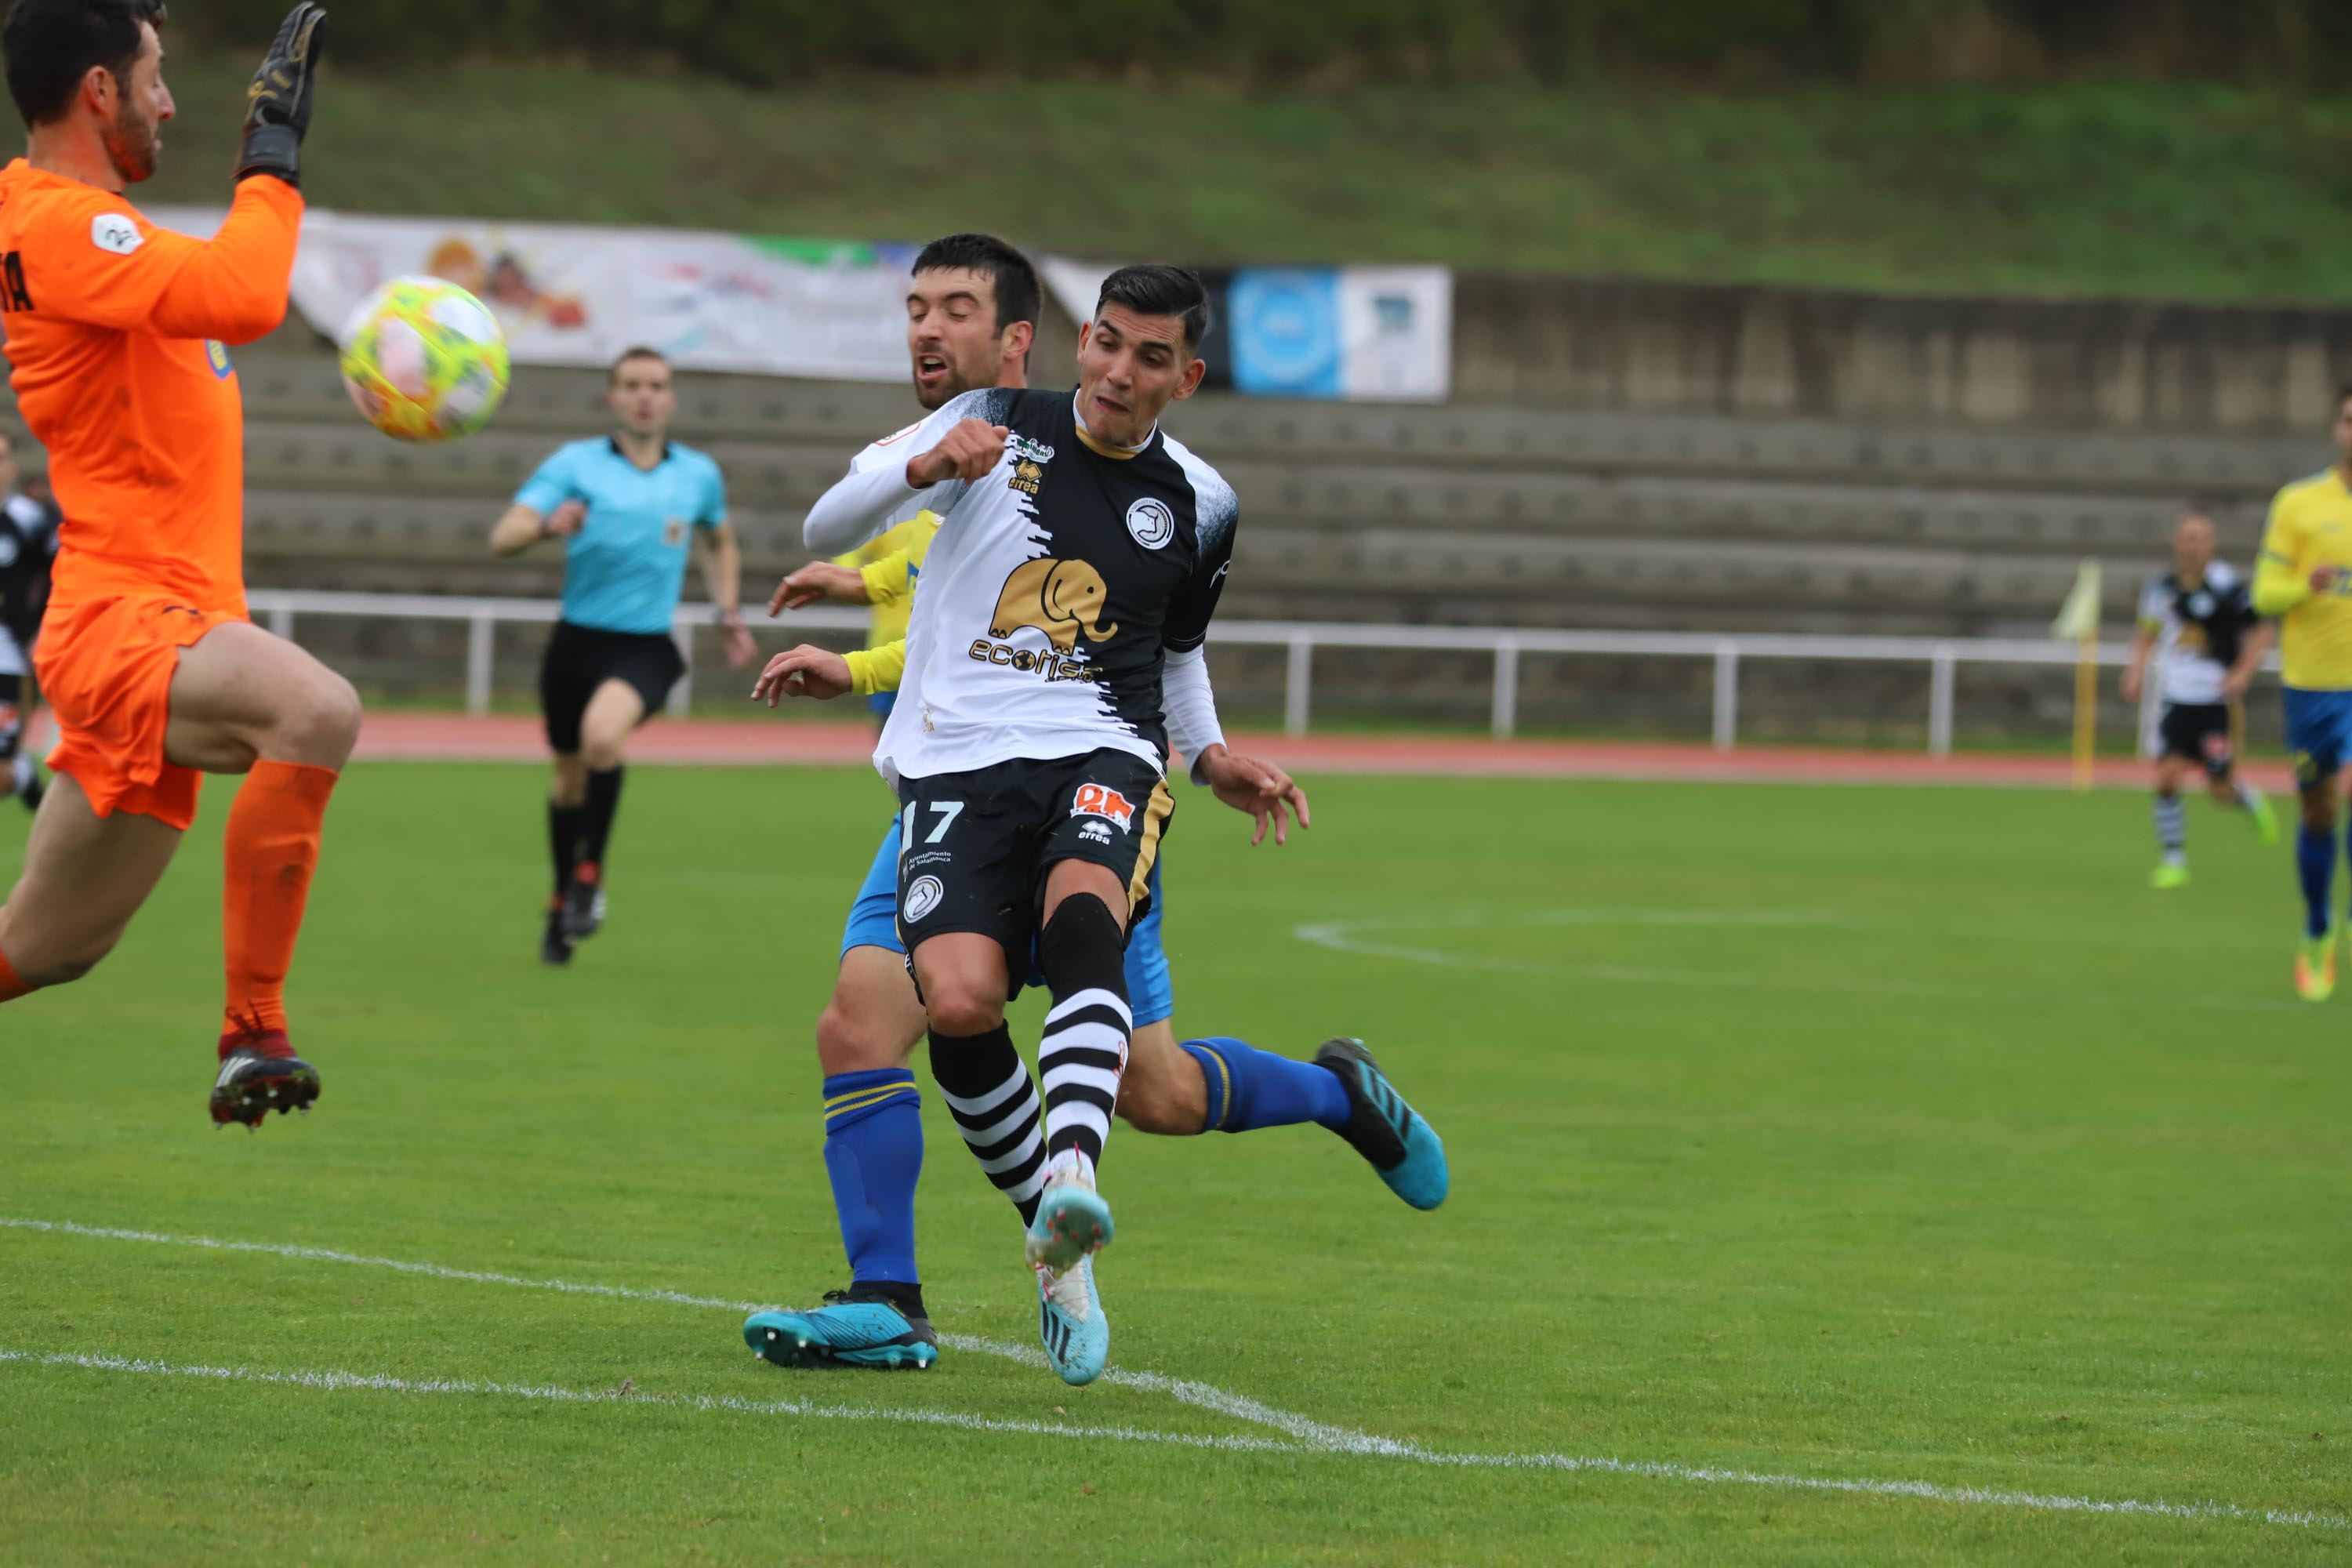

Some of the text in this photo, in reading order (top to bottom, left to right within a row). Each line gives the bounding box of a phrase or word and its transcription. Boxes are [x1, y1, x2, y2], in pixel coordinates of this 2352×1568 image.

[1008, 477, 1040, 495] errea
[902, 800, 965, 855] 17
[1078, 831, 1110, 845] errea
[909, 851, 952, 866] Ayuntamiento
[916, 856, 951, 866] Salamanca
